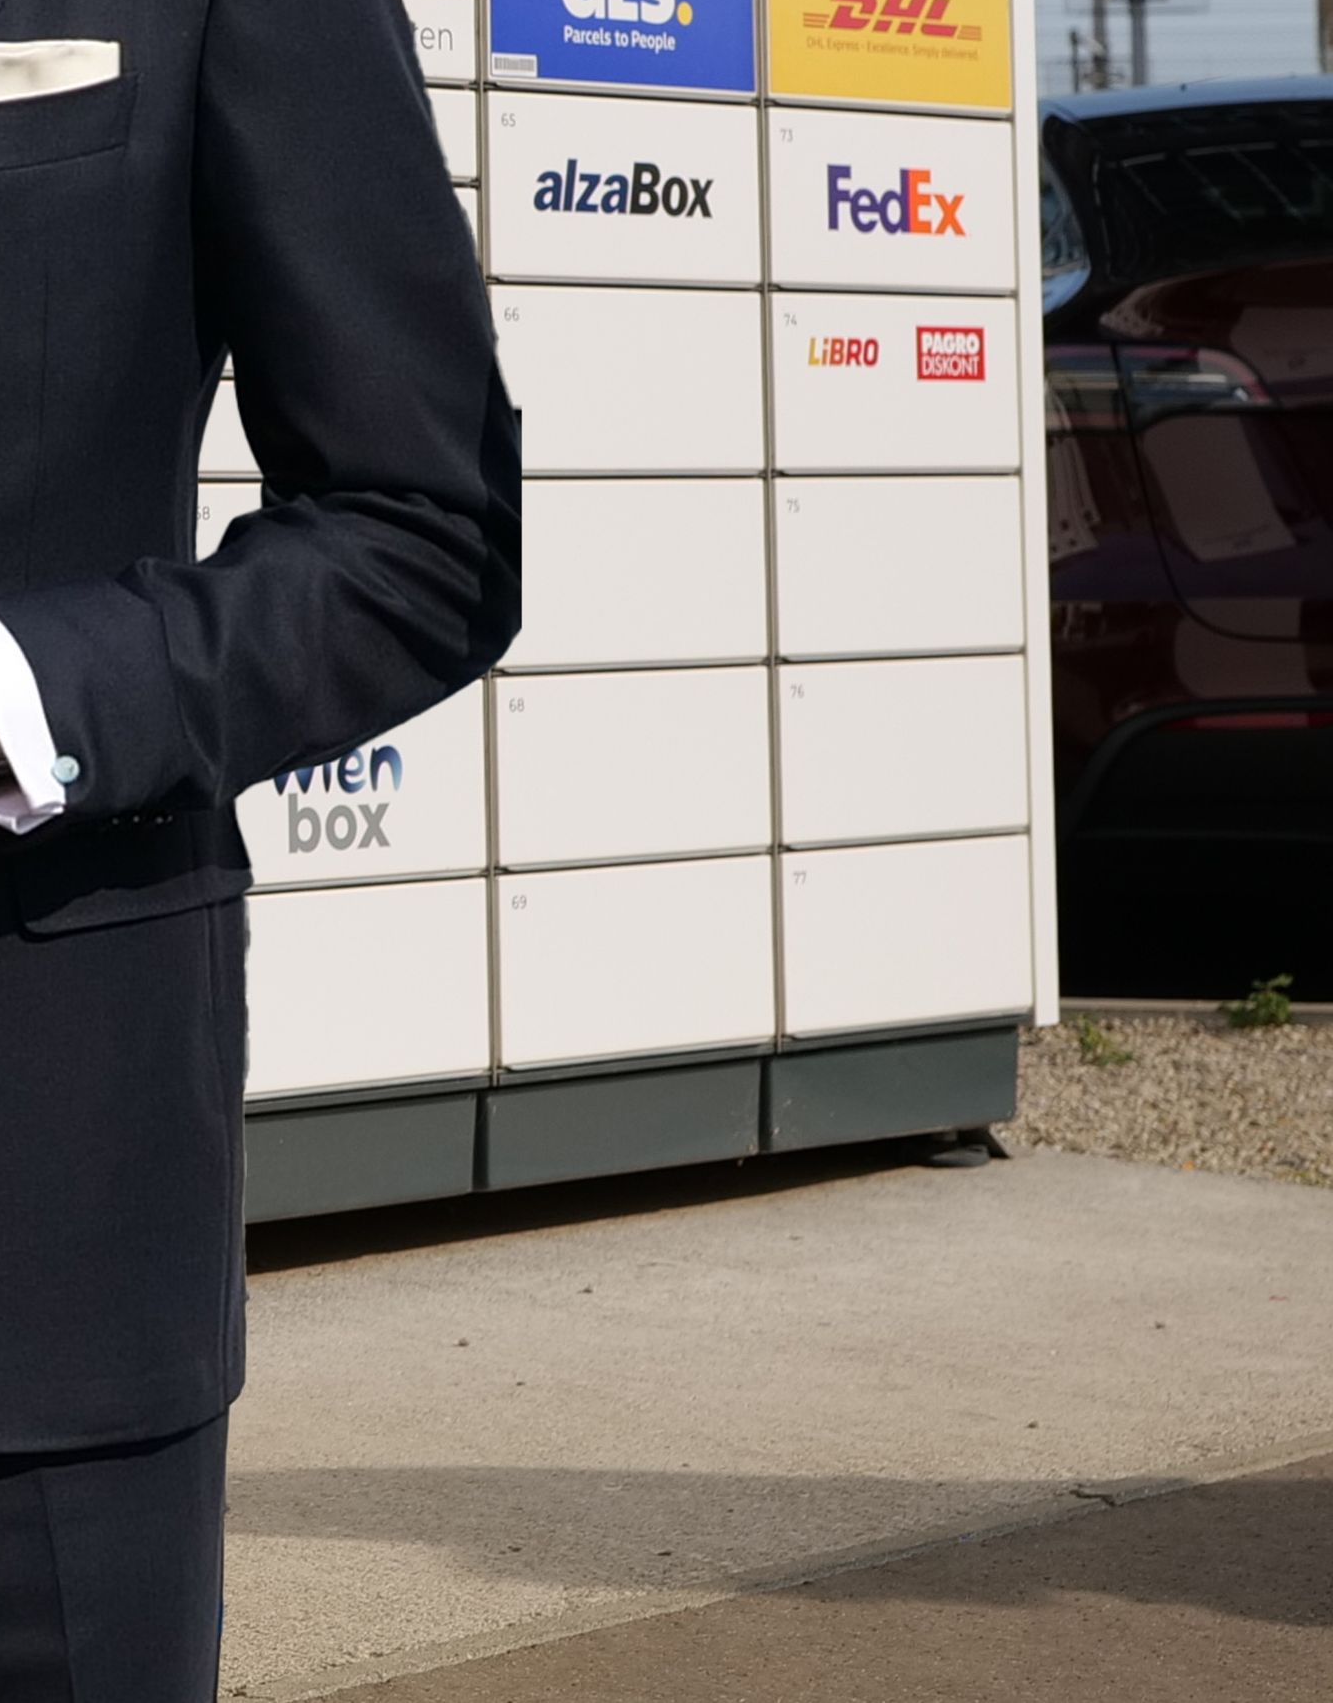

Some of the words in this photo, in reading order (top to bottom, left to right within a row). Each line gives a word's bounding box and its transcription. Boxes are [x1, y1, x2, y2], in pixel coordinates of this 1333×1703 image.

[564, 25, 611, 45] Parcels
[614, 31, 629, 47] to
[631, 30, 675, 53] People
[501, 113, 516, 127] 65
[780, 128, 793, 142] 73
[534, 159, 713, 217] alzaBox
[827, 165, 965, 235] FedEx
[504, 307, 519, 321] 66
[784, 313, 797, 326] 74
[921, 332, 979, 355] PAGRO
[921, 356, 980, 377] DISKONT
[787, 499, 800, 513] 75
[790, 684, 804, 698] 76
[509, 698, 525, 713] 68
[288, 793, 391, 854] box
[793, 871, 806, 884] 77
[512, 895, 527, 910] 69
